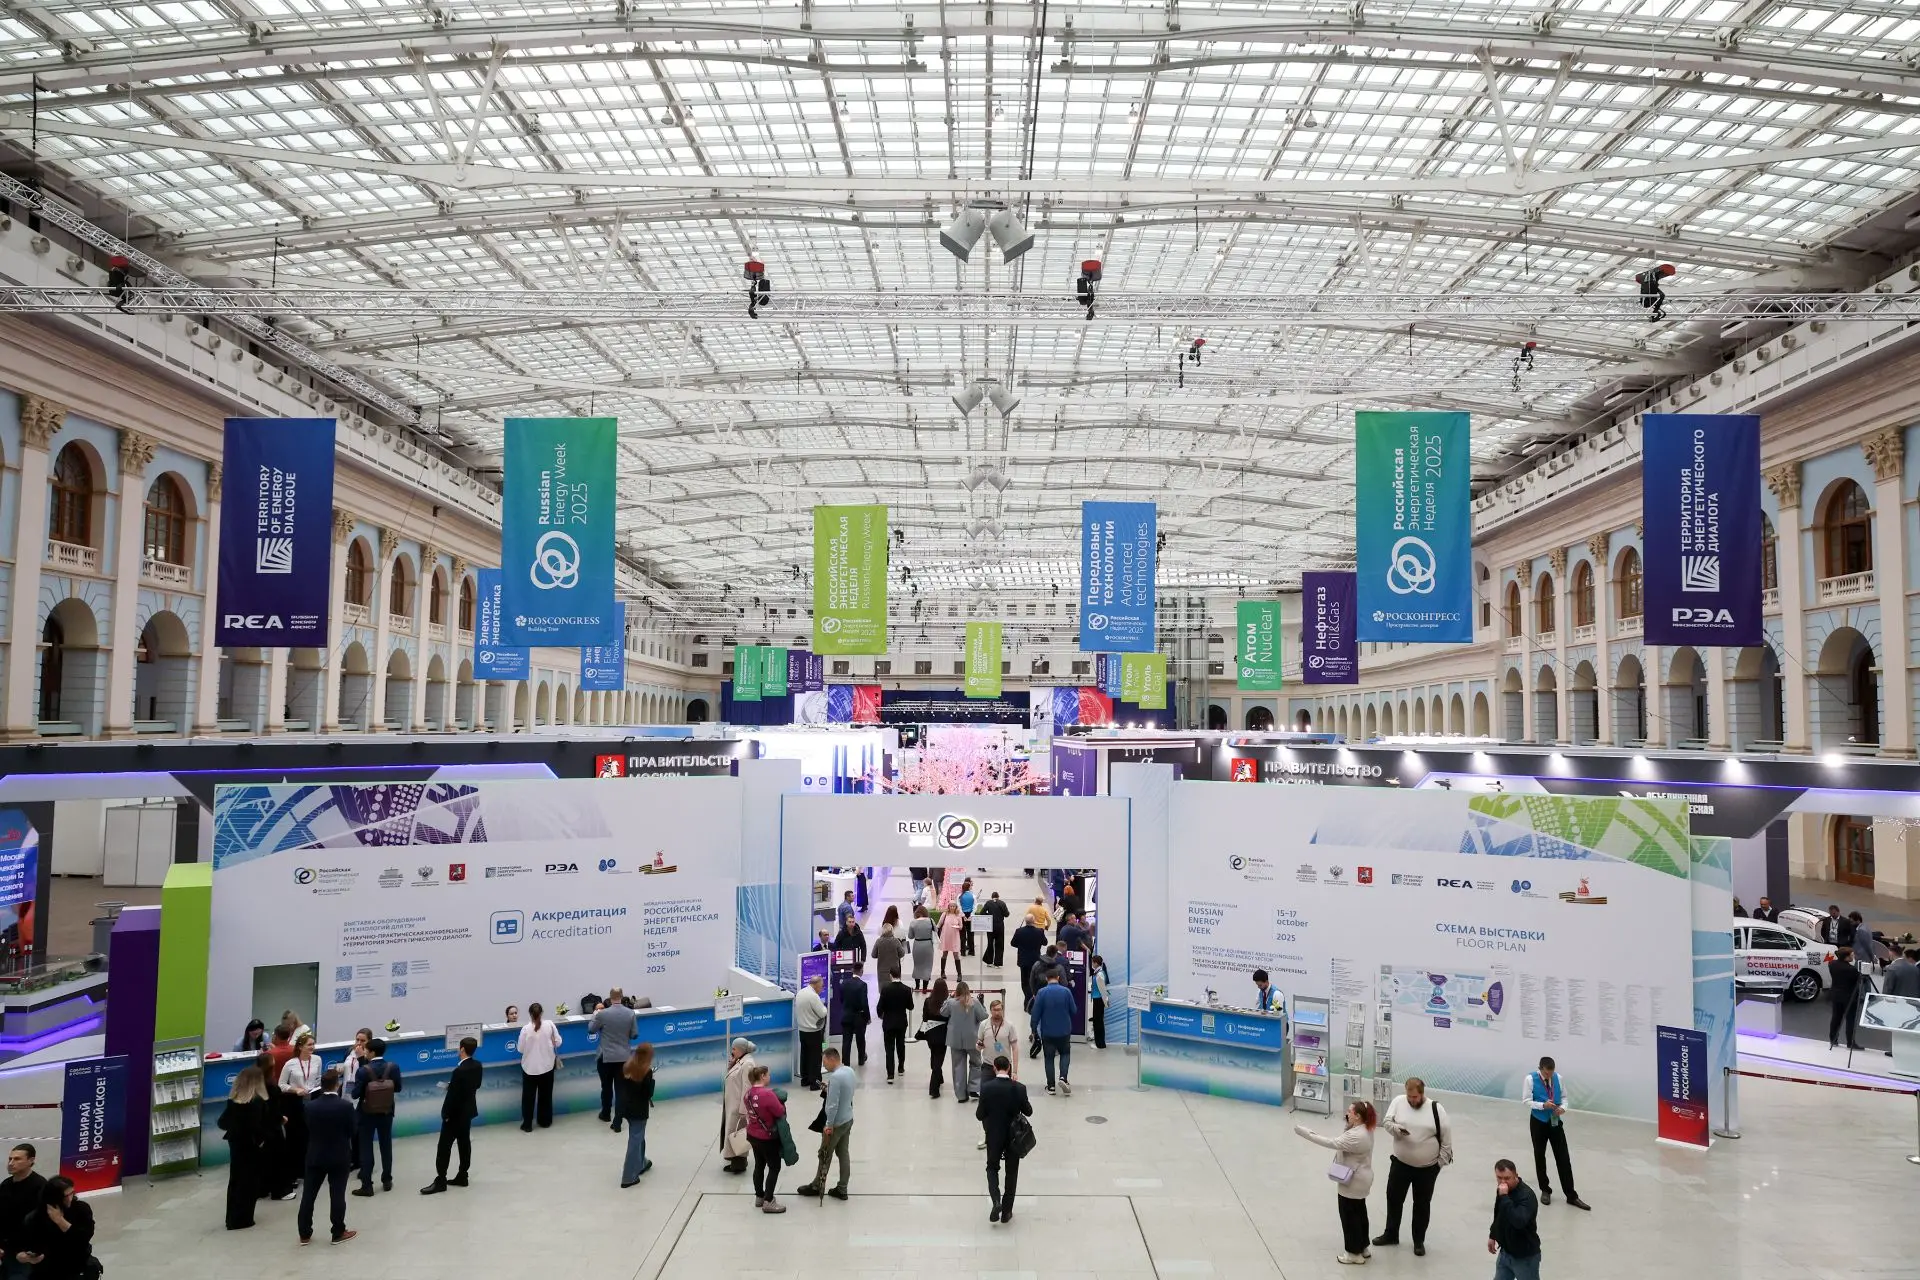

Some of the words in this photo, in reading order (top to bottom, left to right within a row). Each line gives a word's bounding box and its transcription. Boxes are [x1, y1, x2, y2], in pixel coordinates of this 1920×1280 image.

[554, 442, 566, 479] Week
[1425, 435, 1442, 478] 2025
[272, 467, 283, 515] ENERGY
[1392, 448, 1404, 530] Российская
[1408, 426, 1422, 531] Энергетическая
[1694, 429, 1705, 552] ЭНЕРГЕТИЧЕСКОГО
[258, 465, 270, 534] TERRITORY
[284, 472, 296, 534] DIALOGUE
[538, 470, 550, 525] Russian
[554, 481, 569, 525] Energy
[571, 483, 588, 525] 2025
[1424, 482, 1436, 531] Неделя
[1681, 468, 1692, 552] ТЕРРИТОРИЯ
[271, 517, 281, 534] OF
[1708, 492, 1720, 553] ДИАЛОГА
[839, 516, 848, 609] ЭНЕРГЕТИЧЕСКАЯ
[863, 541, 873, 571] Energy
[1087, 522, 1102, 605] Передовые
[1104, 520, 1115, 607] технологии
[1135, 522, 1150, 607] technologies
[828, 538, 838, 609] РОССИЙСКАЯ
[1120, 542, 1133, 607] Advanced
[849, 567, 859, 609] НЕДЕЛЯ
[862, 573, 871, 609] Russian
[224, 614, 284, 629] REA
[479, 596, 492, 646] Электро-
[491, 584, 501, 646] энергетика
[527, 616, 600, 625] ROSCONGRESS
[1315, 586, 1329, 650] Нефтегаз
[1328, 601, 1340, 650] Oil&Gas
[1386, 612, 1461, 621] РОСКОНГРЕСС
[1672, 608, 1734, 622] РЭА
[1260, 607, 1272, 662] Nuclear
[1125, 663, 1133, 688] Уголь
[1143, 664, 1152, 692] Уголь
[629, 755, 731, 768] ПРАВИТЕЛЬСТВ
[1264, 761, 1383, 777] ПРАВИТЕЛЬСТВО
[898, 822, 932, 833] REW
[984, 822, 1013, 834] РЭН
[545, 863, 579, 873] РЭА
[1437, 878, 1473, 888] REA
[532, 907, 627, 922] Аккредитация
[643, 905, 702, 916] РОССИЙСКАЯ
[643, 913, 719, 926] ЭНЕРГЕТИЧЕСКАЯ
[1188, 906, 1224, 917] RUSSIAN
[1188, 916, 1220, 926] ENERGY
[1276, 919, 1309, 928] october
[350, 930, 424, 941] НАУЧНО-ПРАКТИЧЕСКАЯ
[424, 927, 469, 936] КОНФЕРЕНЦИЯ
[386, 935, 441, 945] ЭНЕРГЕТИЧЕСКОГО
[531, 924, 612, 939] Accreditation
[643, 926, 678, 936] НЕДЕЛЯ
[1188, 926, 1211, 935] WEEK
[1276, 933, 1296, 942] 2025
[1435, 923, 1477, 935] СХЕМА
[1479, 926, 1545, 941] ВЫСТАВКИ
[646, 949, 680, 958] октября
[1456, 937, 1494, 949] FLOOR
[1497, 941, 1526, 953] PLAN
[646, 965, 666, 974] 2025
[1226, 966, 1245, 974] ENERGY
[1275, 966, 1308, 975] CONFERENCE
[1747, 962, 1800, 970] ОСВЕЩЕНИЯ
[1748, 969, 1785, 977] МОСКВЫ
[1671, 1060, 1680, 1099] ВЫБИРАЙ
[1681, 1045, 1690, 1101] РОССИЙСКОЕ!
[79, 1102, 91, 1152] ВЫБИРАЙ
[93, 1076, 106, 1150] РОССИЙСКОЕ!
